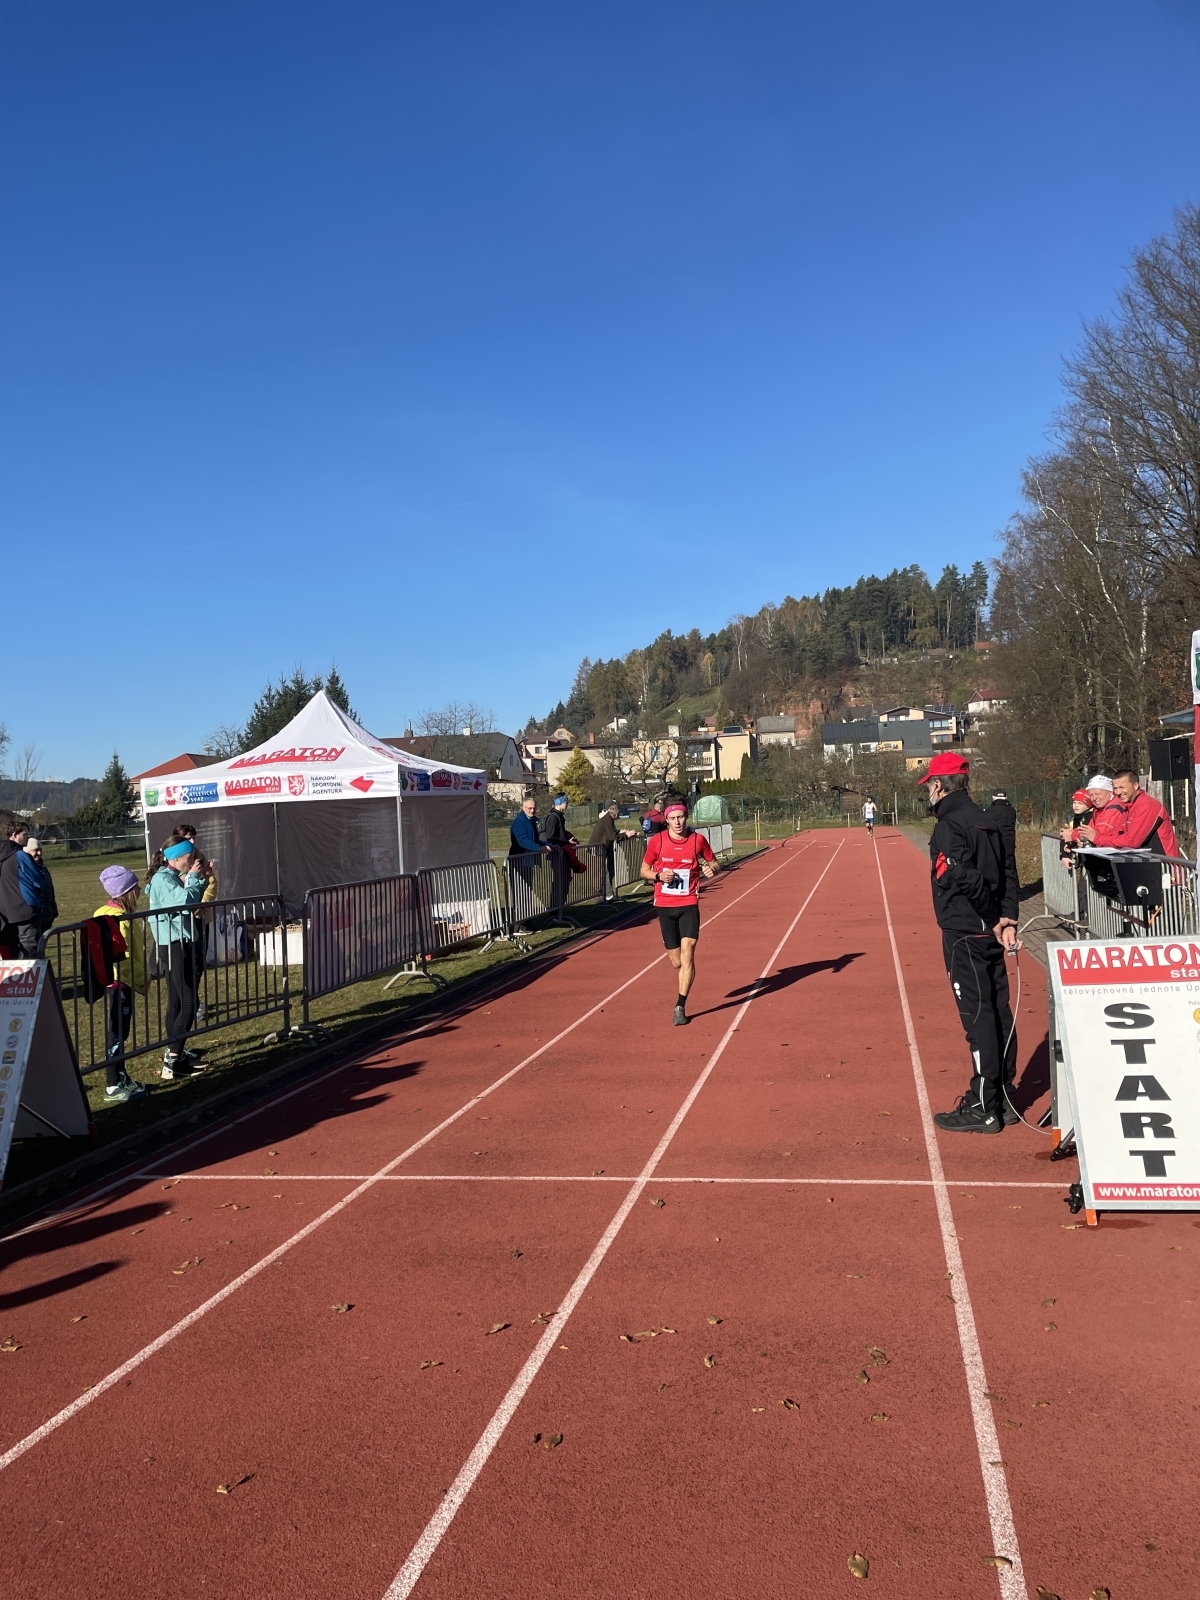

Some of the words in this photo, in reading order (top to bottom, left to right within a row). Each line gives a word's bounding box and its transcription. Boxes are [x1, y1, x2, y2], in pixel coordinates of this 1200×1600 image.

[233, 747, 346, 765] MARATON
[225, 776, 281, 791] MARATON
[1170, 967, 1200, 978] sta
[6, 985, 33, 995] stav
[1063, 986, 1135, 996] tělovýchovná
[1139, 983, 1181, 994] jednota
[1104, 1003, 1177, 1177] START
